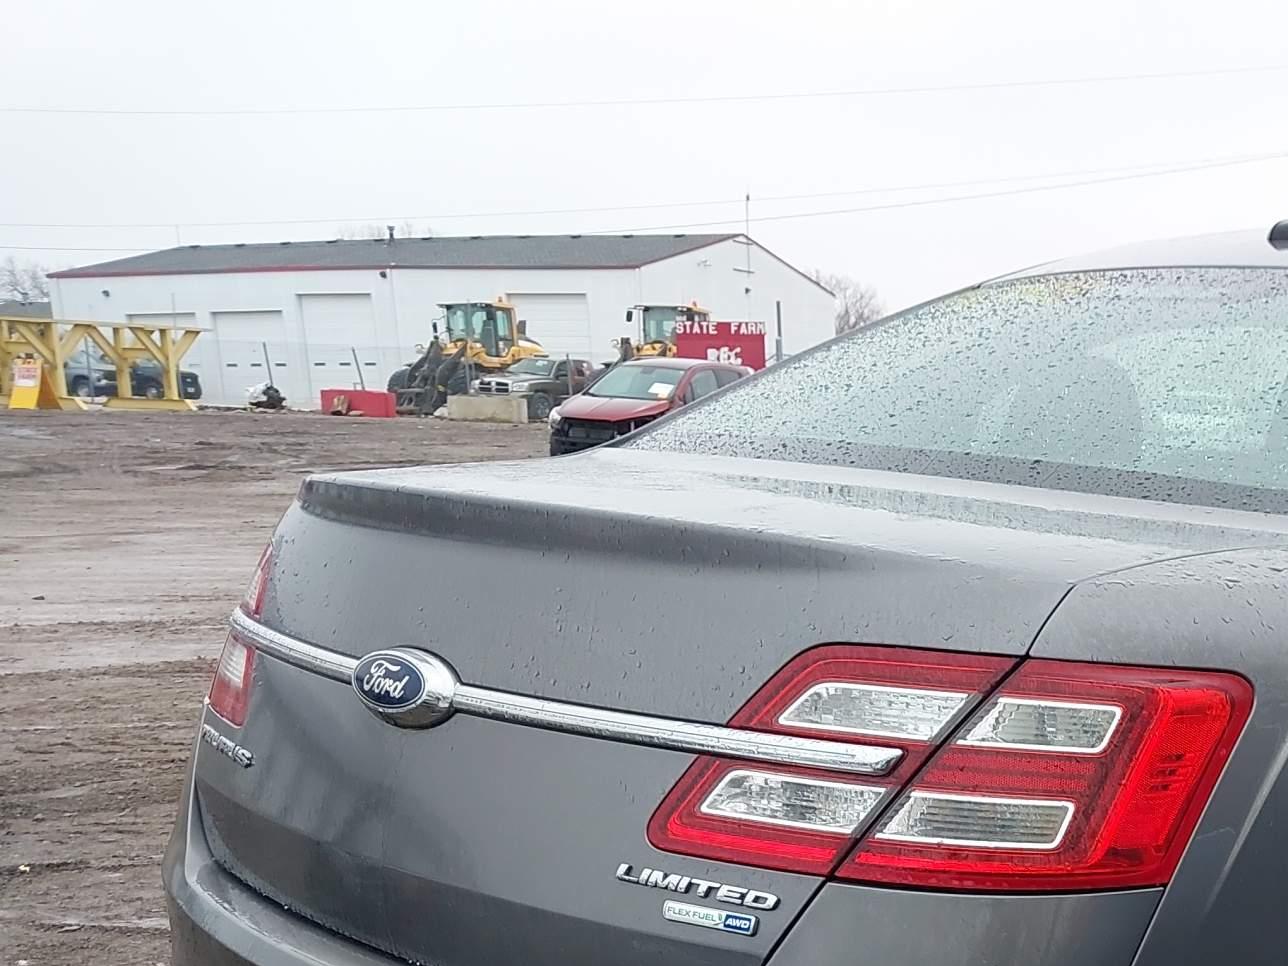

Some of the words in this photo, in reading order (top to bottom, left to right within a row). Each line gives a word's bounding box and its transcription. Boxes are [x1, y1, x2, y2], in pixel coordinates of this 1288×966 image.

[676, 321, 718, 334] STATE
[731, 322, 766, 335] FARM
[363, 660, 410, 699] Ford
[616, 863, 781, 911] LIMITED
[667, 905, 691, 917] FLEX
[692, 910, 717, 923] FUEL
[725, 916, 751, 930] AWD
